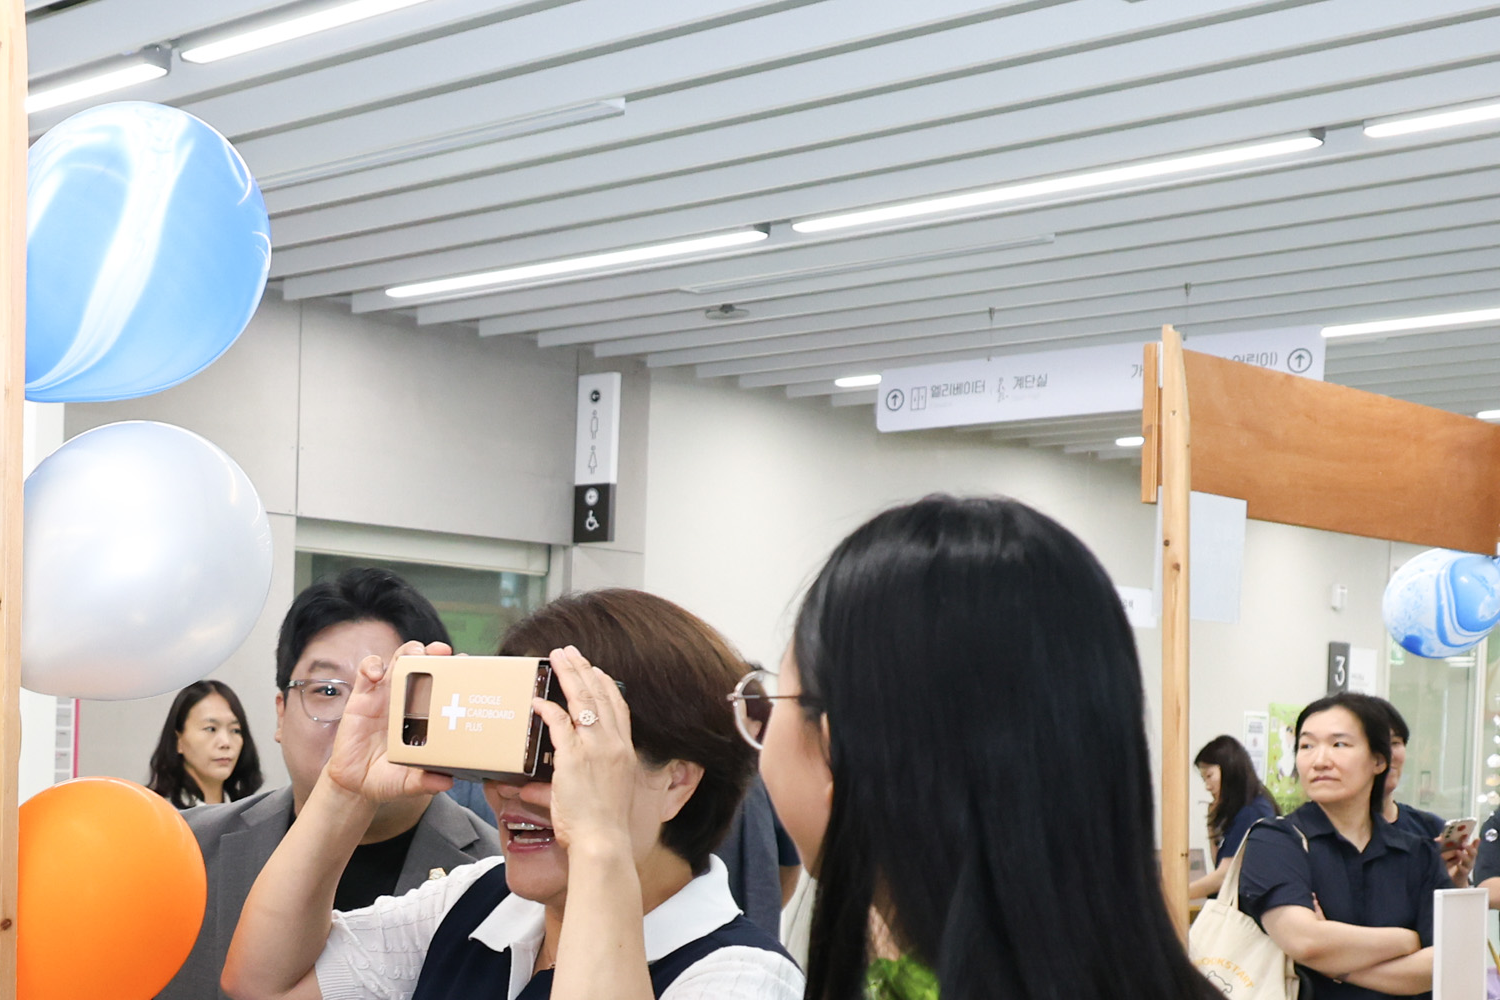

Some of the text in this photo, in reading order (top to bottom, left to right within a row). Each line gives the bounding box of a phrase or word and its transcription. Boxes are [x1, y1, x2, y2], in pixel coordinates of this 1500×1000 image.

[930, 373, 1048, 398] 엘리베이터 계단실
[1334, 655, 1346, 686] 3
[468, 694, 502, 706] GOOGLE
[466, 708, 516, 720] CARDBOARD
[464, 721, 484, 732] PLUS
